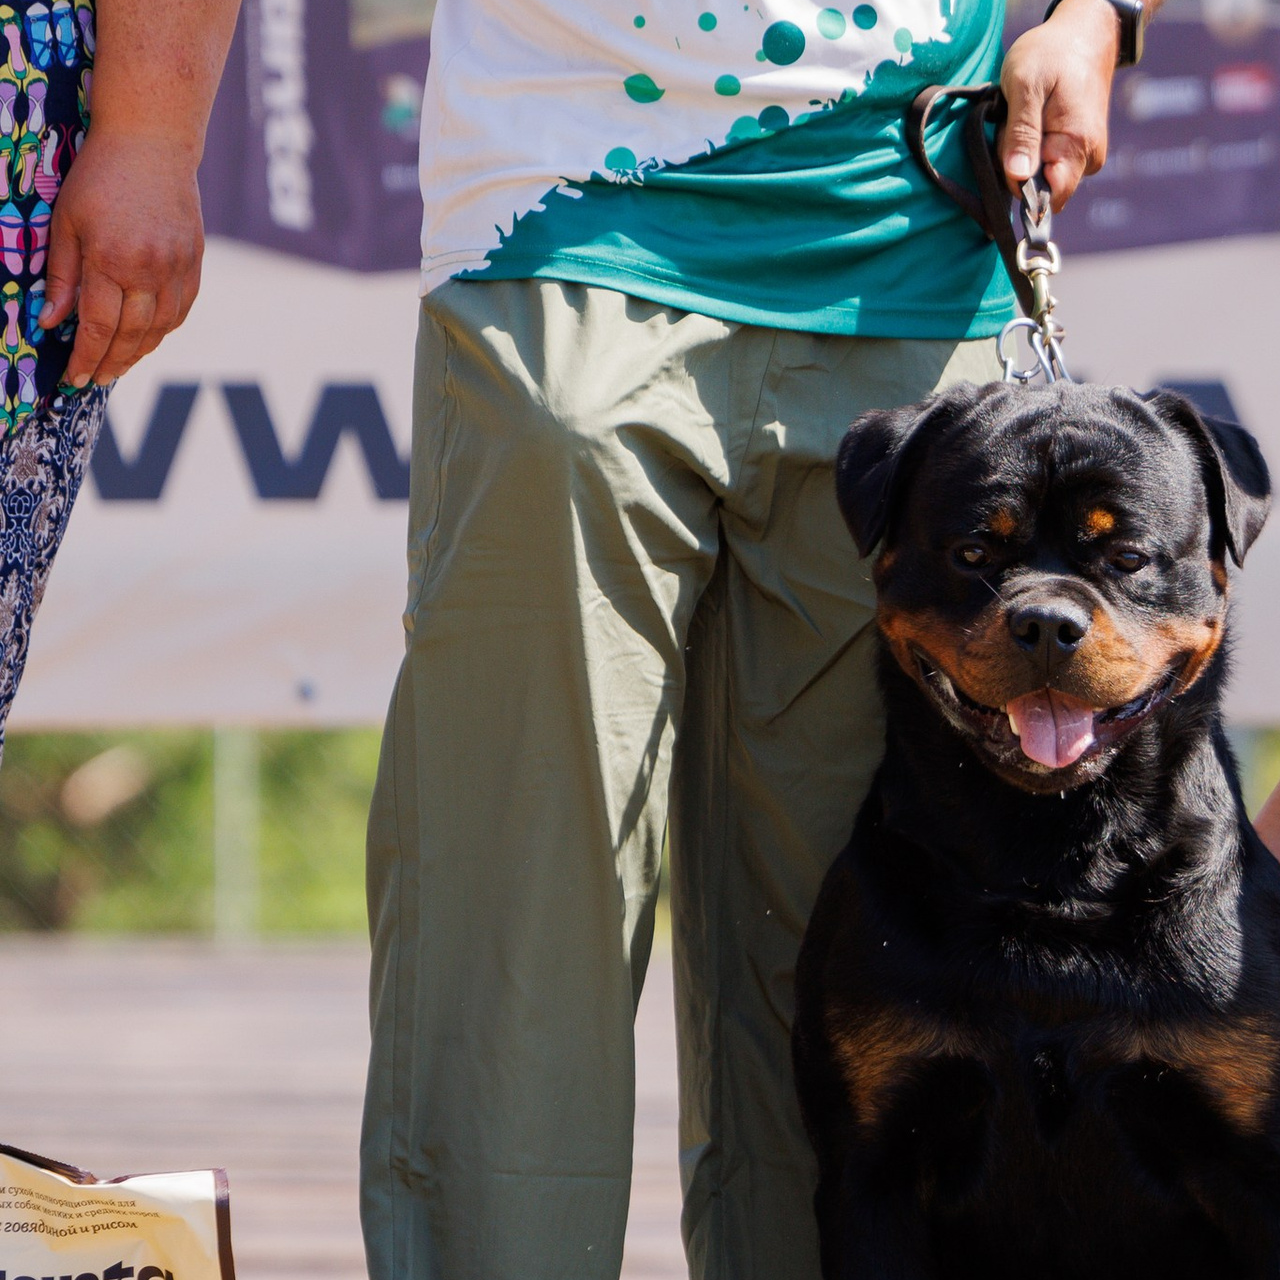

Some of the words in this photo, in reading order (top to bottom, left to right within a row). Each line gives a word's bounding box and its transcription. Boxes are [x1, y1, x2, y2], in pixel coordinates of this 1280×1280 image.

[14, 1200, 42, 1211] собак
[4, 1219, 77, 1238] говядиной
[80, 1226, 89, 1234] и
[91, 1220, 138, 1235] рисом
